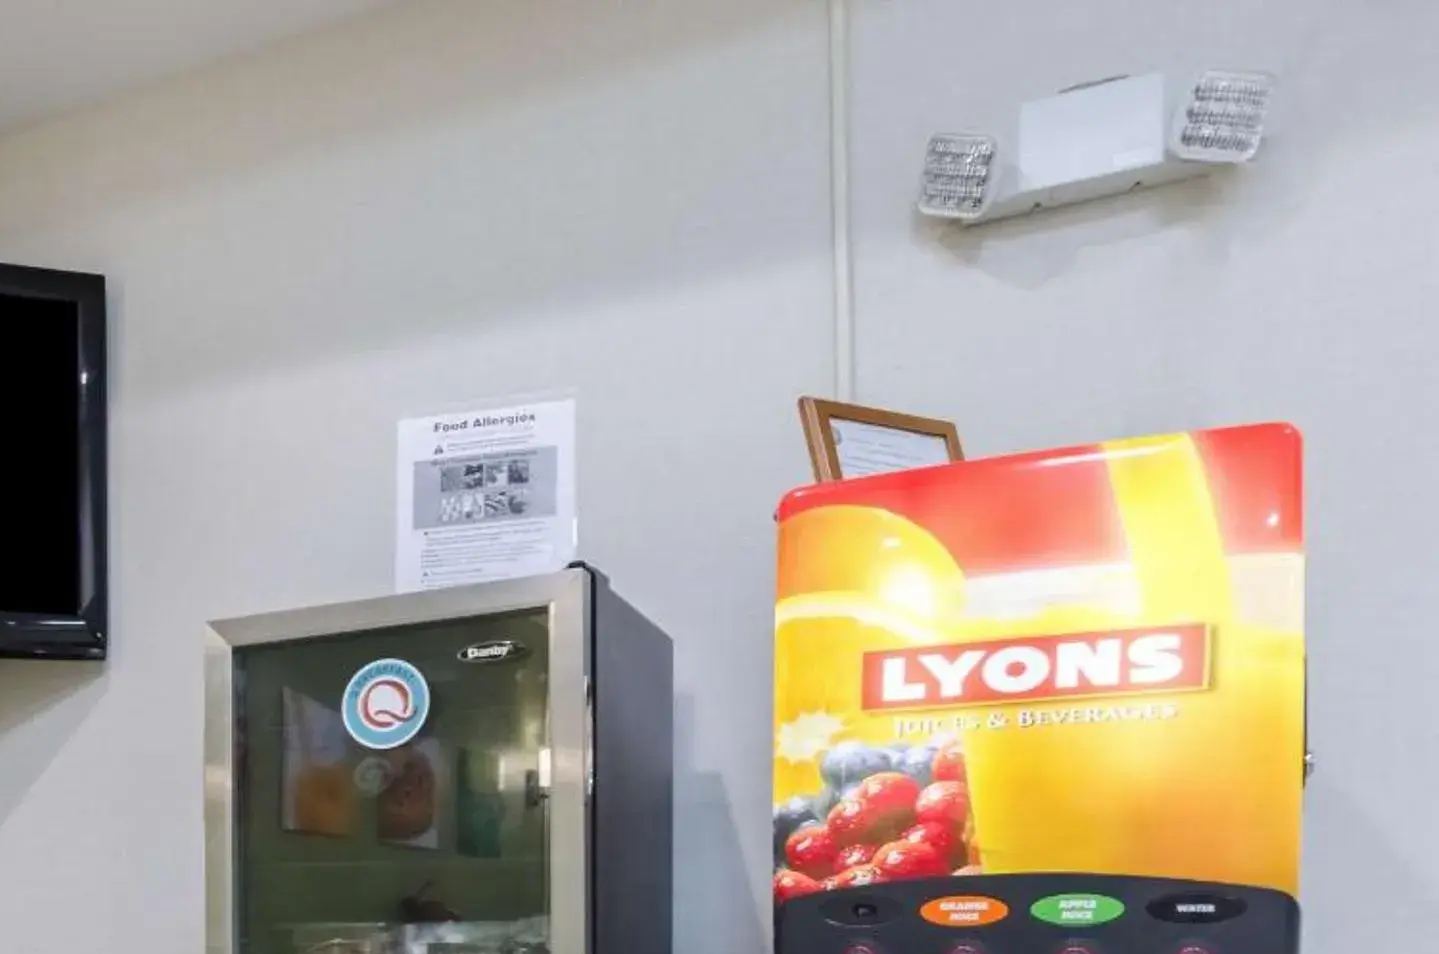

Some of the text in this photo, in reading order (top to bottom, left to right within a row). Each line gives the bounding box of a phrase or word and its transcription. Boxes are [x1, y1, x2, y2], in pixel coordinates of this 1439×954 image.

[433, 413, 536, 433] Food Allergies
[881, 633, 1184, 702] LYONS
